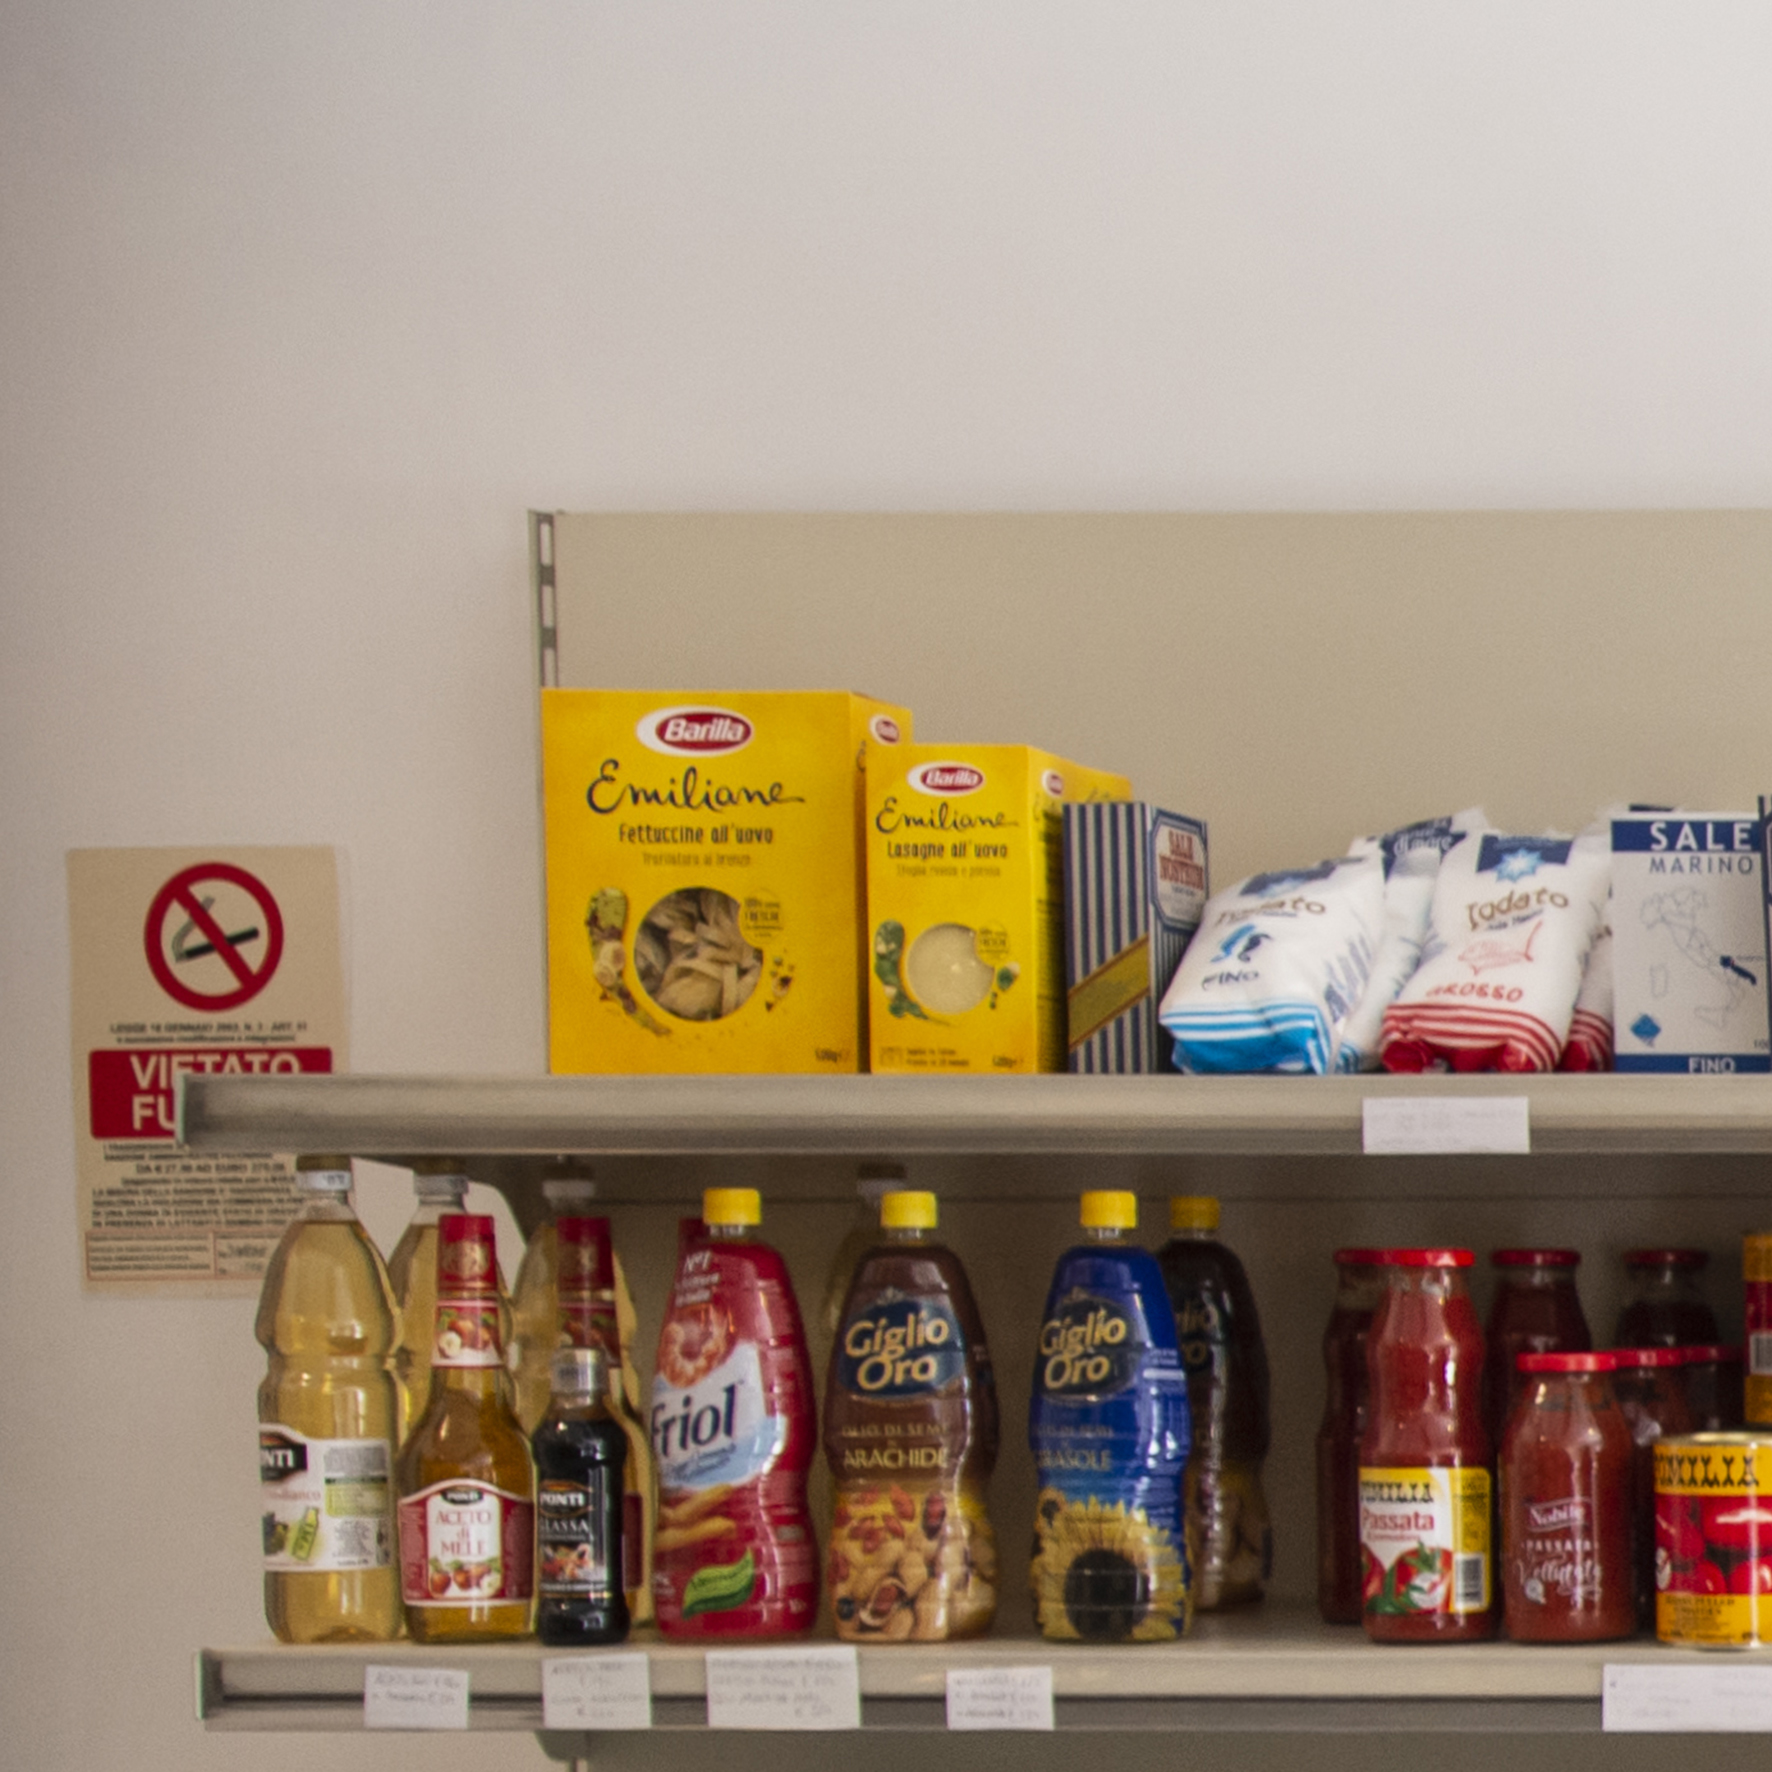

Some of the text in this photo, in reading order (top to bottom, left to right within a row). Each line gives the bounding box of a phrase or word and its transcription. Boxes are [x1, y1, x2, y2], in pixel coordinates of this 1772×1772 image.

[664, 717, 745, 744] Barilla
[586, 758, 806, 815] Emiliane
[926, 770, 984, 789] Barilla
[875, 797, 1020, 834] Emiliane
[619, 823, 704, 844] Fettuccine
[1650, 821, 1752, 850] SALE
[887, 841, 945, 861] Lasagne
[1650, 855, 1753, 874] MARINO
[1200, 968, 1261, 992] FINO
[1688, 1056, 1737, 1073] FINO
[844, 1309, 950, 1358] Giglio
[1040, 1309, 1127, 1357] Giglio
[857, 1350, 938, 1391] Oro
[1044, 1354, 1110, 1389] Oro
[264, 1449, 295, 1469] NTI
[843, 1449, 949, 1469] ARACHIDE
[435, 1510, 491, 1525] ACETO
[540, 1518, 589, 1533] LASSA
[441, 1540, 487, 1556] MELE
